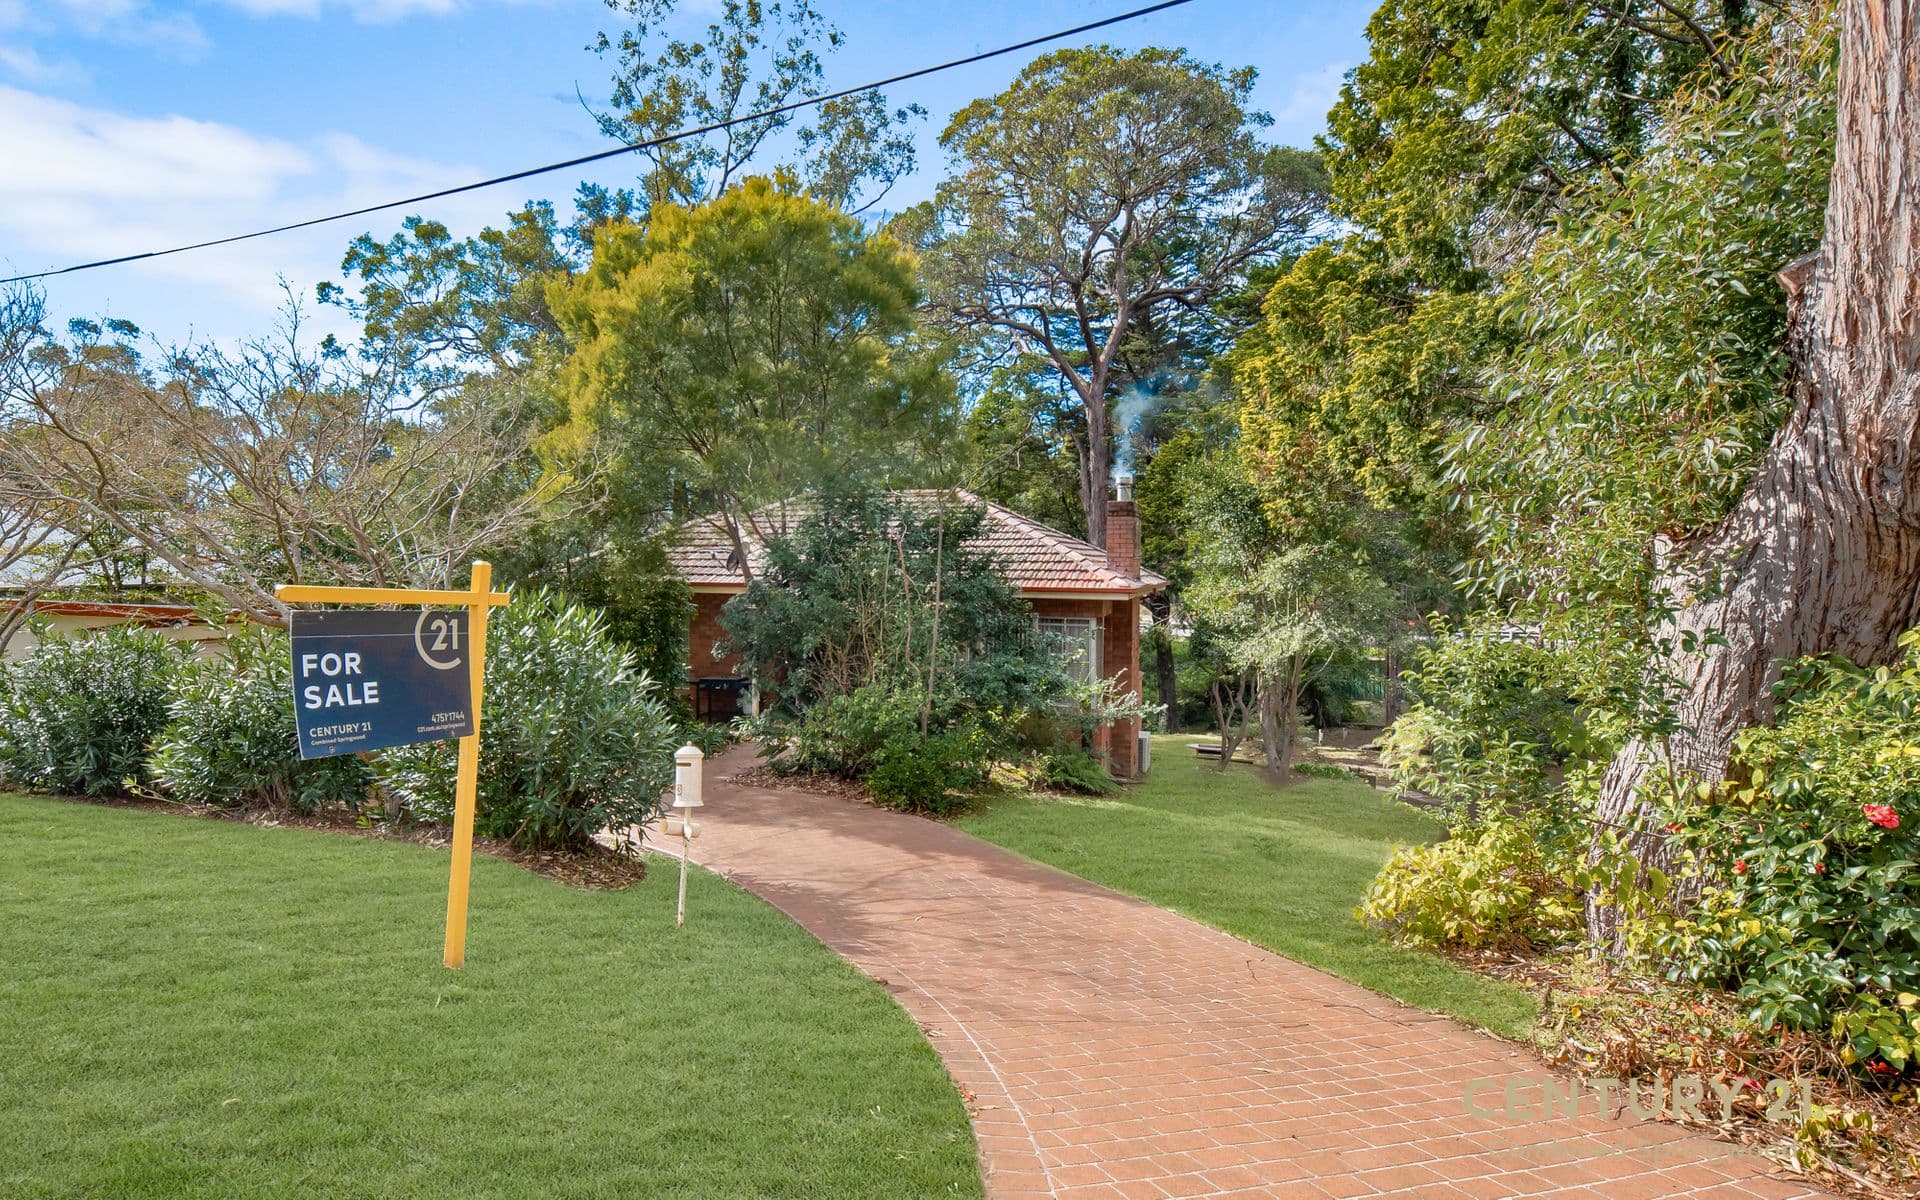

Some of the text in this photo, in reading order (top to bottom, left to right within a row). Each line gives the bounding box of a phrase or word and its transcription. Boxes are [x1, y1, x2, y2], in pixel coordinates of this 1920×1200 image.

[302, 652, 361, 678] FOR
[304, 681, 380, 709] SALE
[309, 721, 372, 737] CENTURY 21
